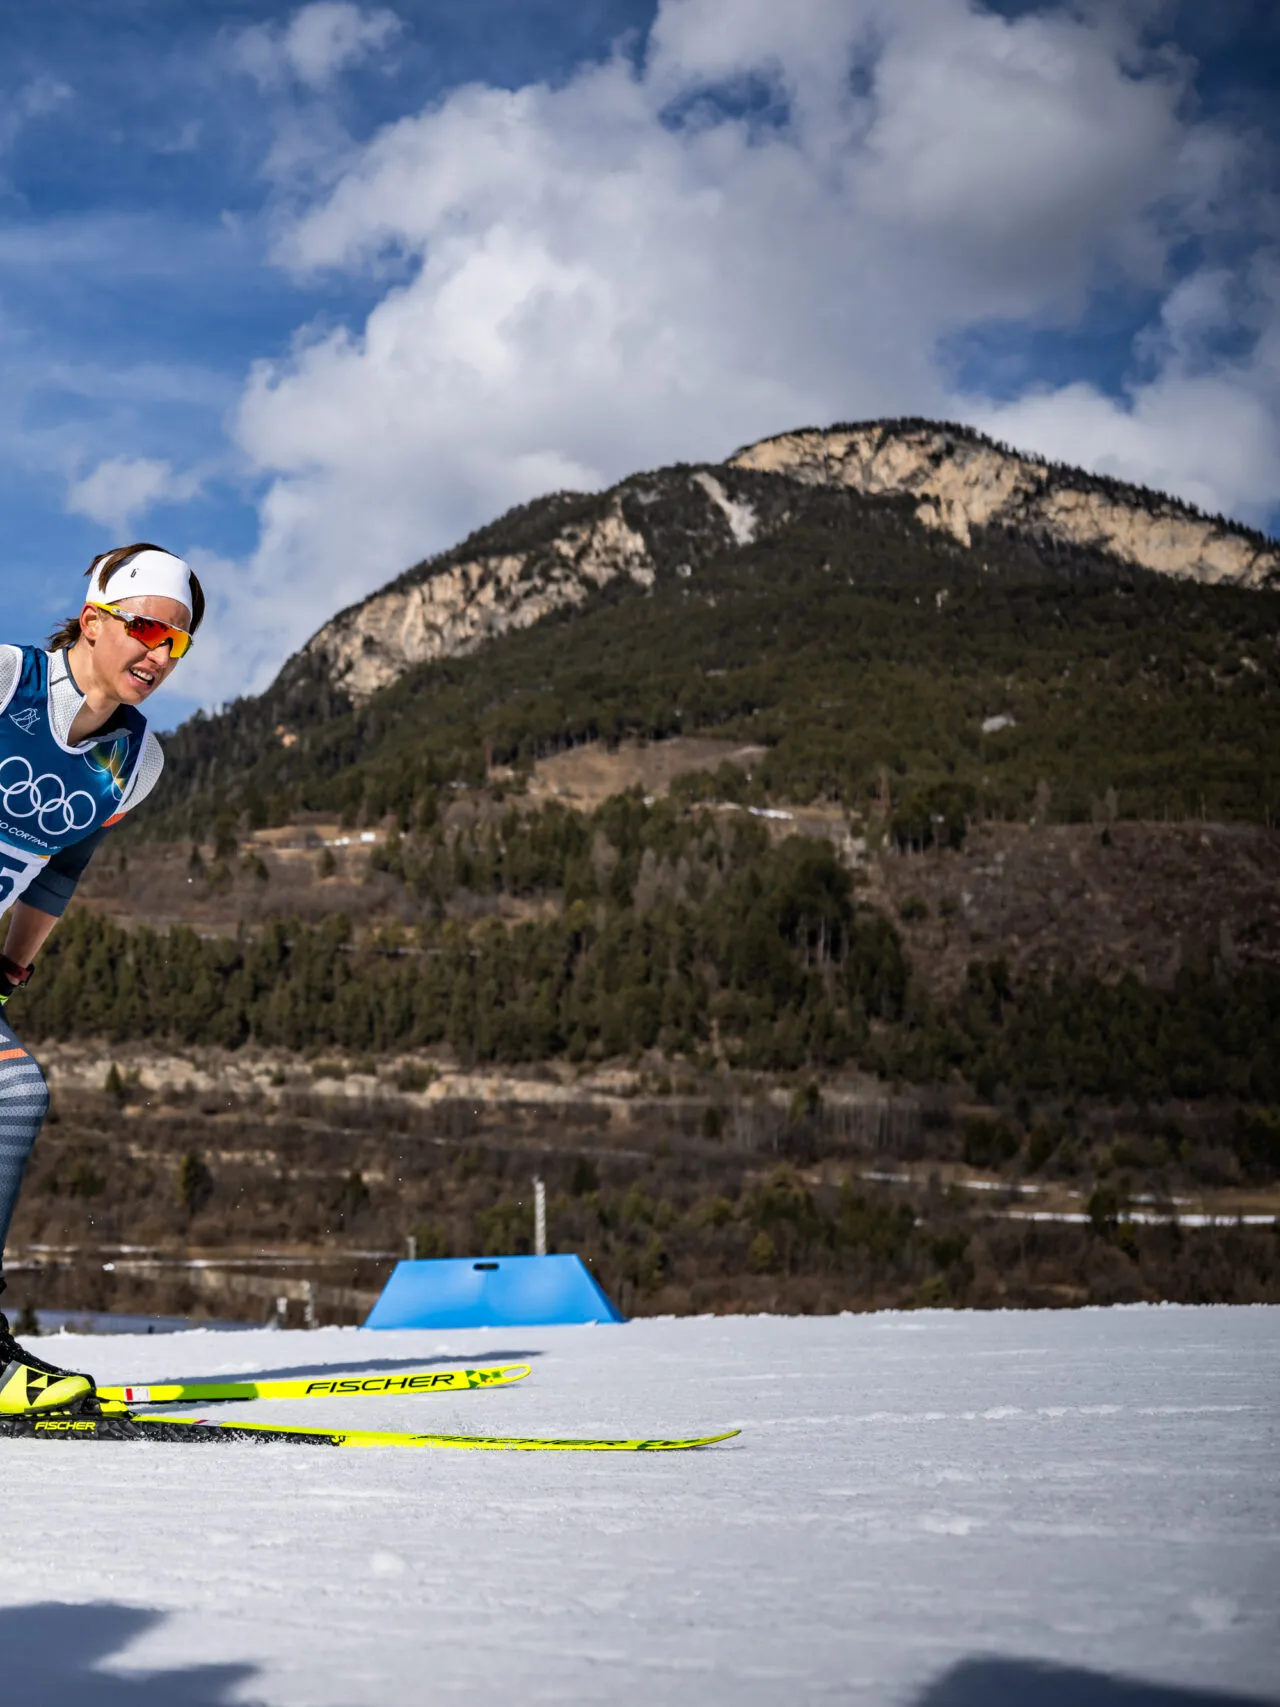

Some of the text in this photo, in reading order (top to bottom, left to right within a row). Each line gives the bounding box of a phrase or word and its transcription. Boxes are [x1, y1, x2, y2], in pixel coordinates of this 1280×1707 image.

[8, 826, 48, 848] CORTINA
[306, 1373, 455, 1395] FISCHER
[35, 1421, 96, 1431] FISCHER
